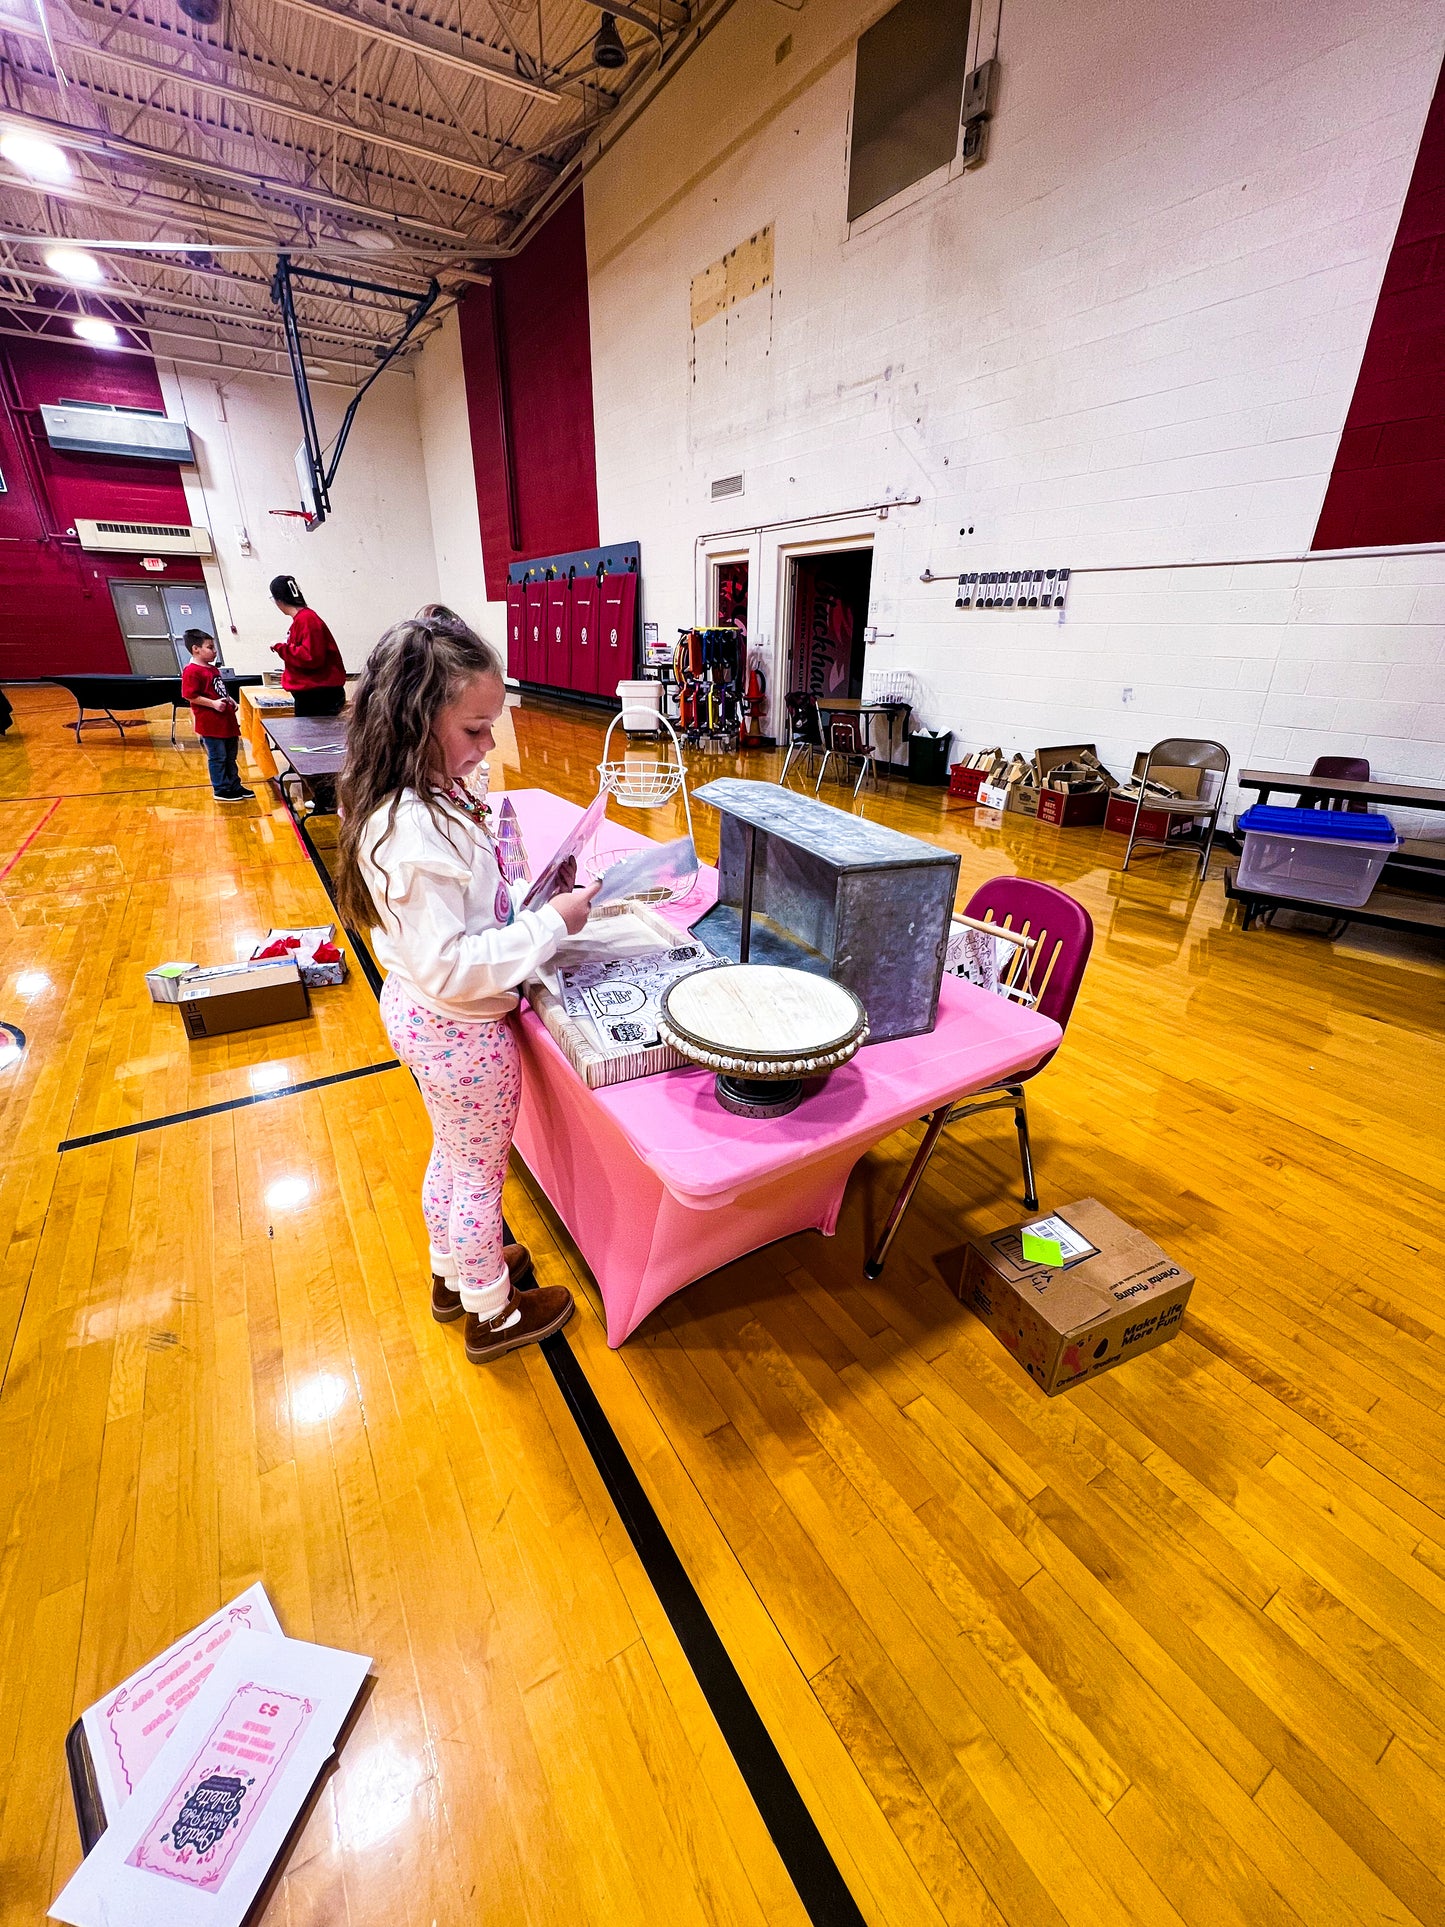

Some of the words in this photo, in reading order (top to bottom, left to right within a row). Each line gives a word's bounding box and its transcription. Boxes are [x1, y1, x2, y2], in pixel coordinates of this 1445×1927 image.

[1147, 1267, 1180, 1284] Oriental
[1114, 1282, 1148, 1301] Trading
[1121, 1327, 1154, 1347] More
[1155, 1310, 1183, 1331] Fun!
[1123, 1316, 1158, 1338] Make
[1159, 1304, 1182, 1319] Life
[258, 1702, 280, 1717] $3
[195, 1789, 244, 1813] Palette
[181, 1807, 205, 1827] Pole
[199, 1811, 233, 1830] North
[176, 1822, 216, 1851] Opal's
